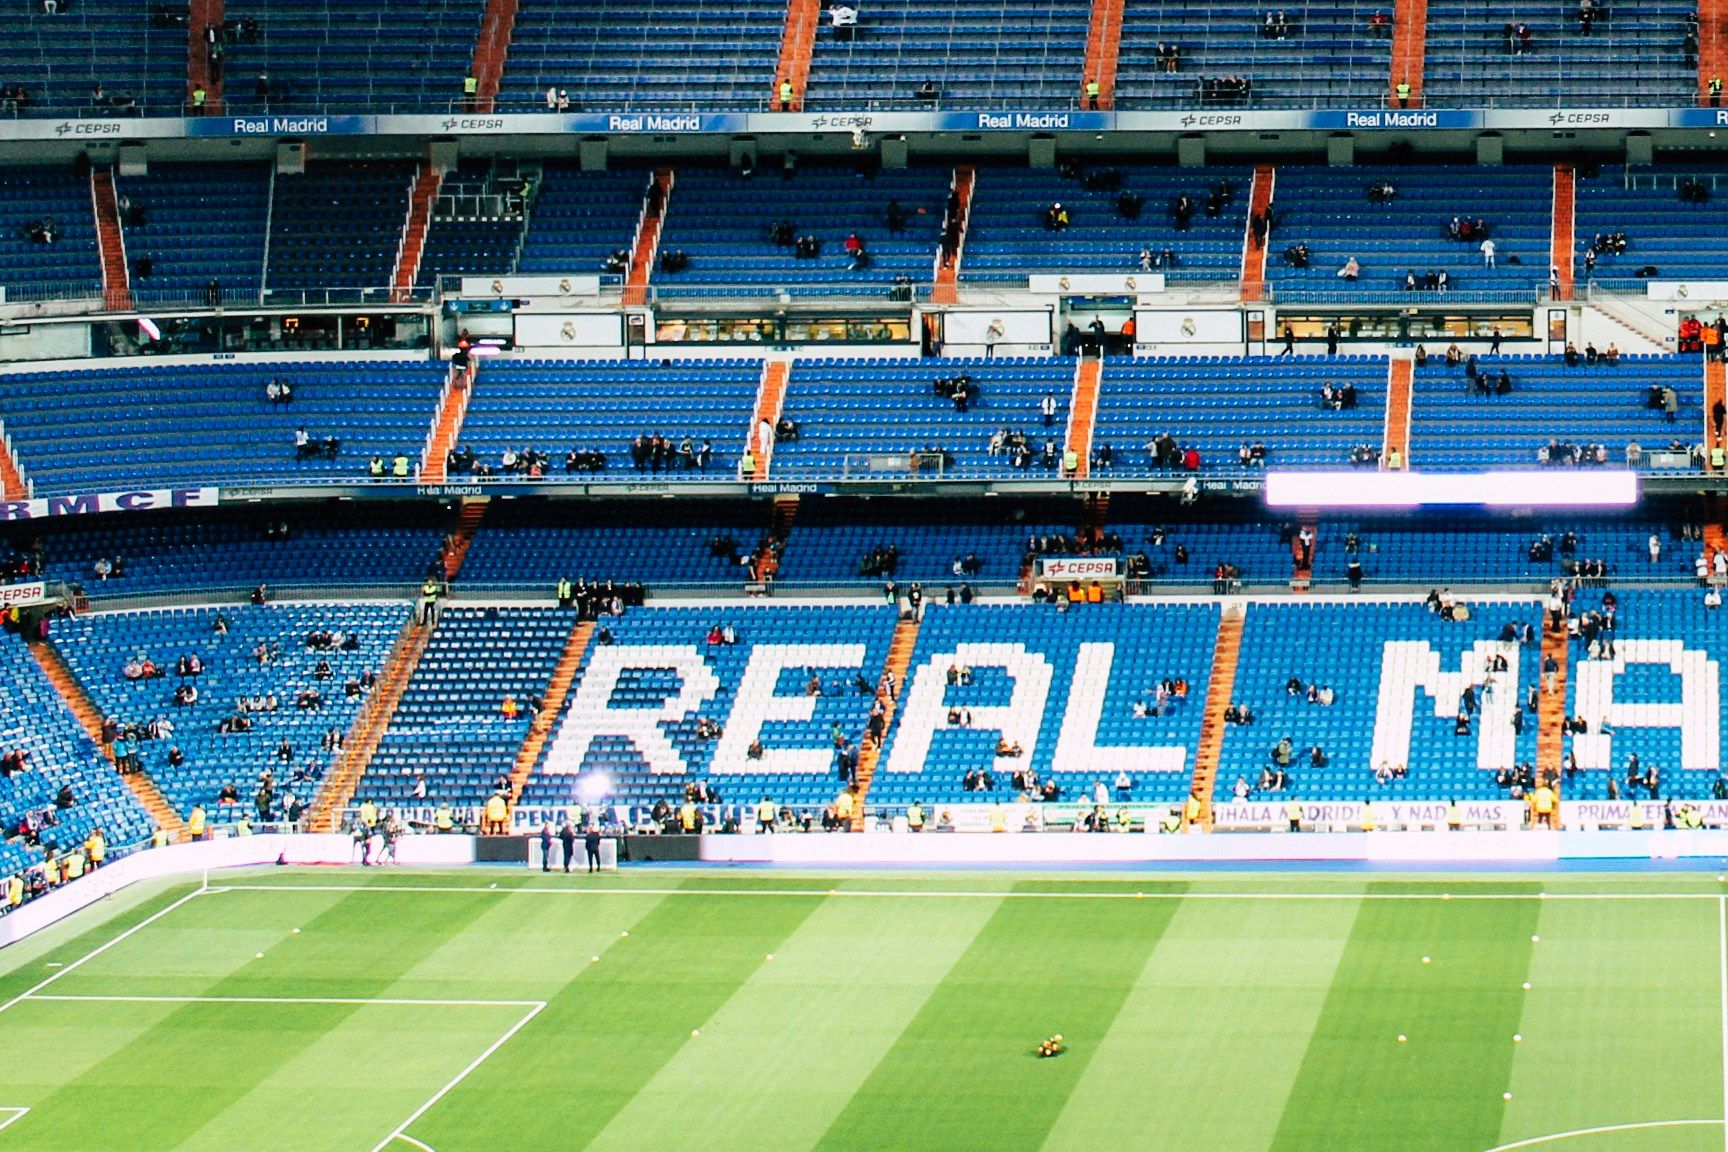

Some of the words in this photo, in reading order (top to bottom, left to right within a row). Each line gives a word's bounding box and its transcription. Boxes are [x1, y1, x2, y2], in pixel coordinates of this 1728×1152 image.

[461, 119, 503, 130] CEPSA
[609, 116, 643, 130] Real
[647, 116, 700, 130] Madrid
[978, 114, 1012, 128] Real
[1016, 114, 1068, 128] Madrid
[1199, 116, 1241, 125] CEPSA
[1347, 113, 1380, 127] Real
[1384, 113, 1436, 127] Madrid
[1567, 113, 1610, 123] CEPSA
[75, 124, 121, 134] CEPSA
[234, 119, 268, 133] Real
[273, 119, 327, 132] Madrid
[1068, 562, 1114, 574] CEPSA
[543, 642, 1187, 776] REAL
[1391, 806, 1401, 820] Y
[1409, 806, 1448, 820] NAD
[1577, 805, 1678, 821] PRIMAER
